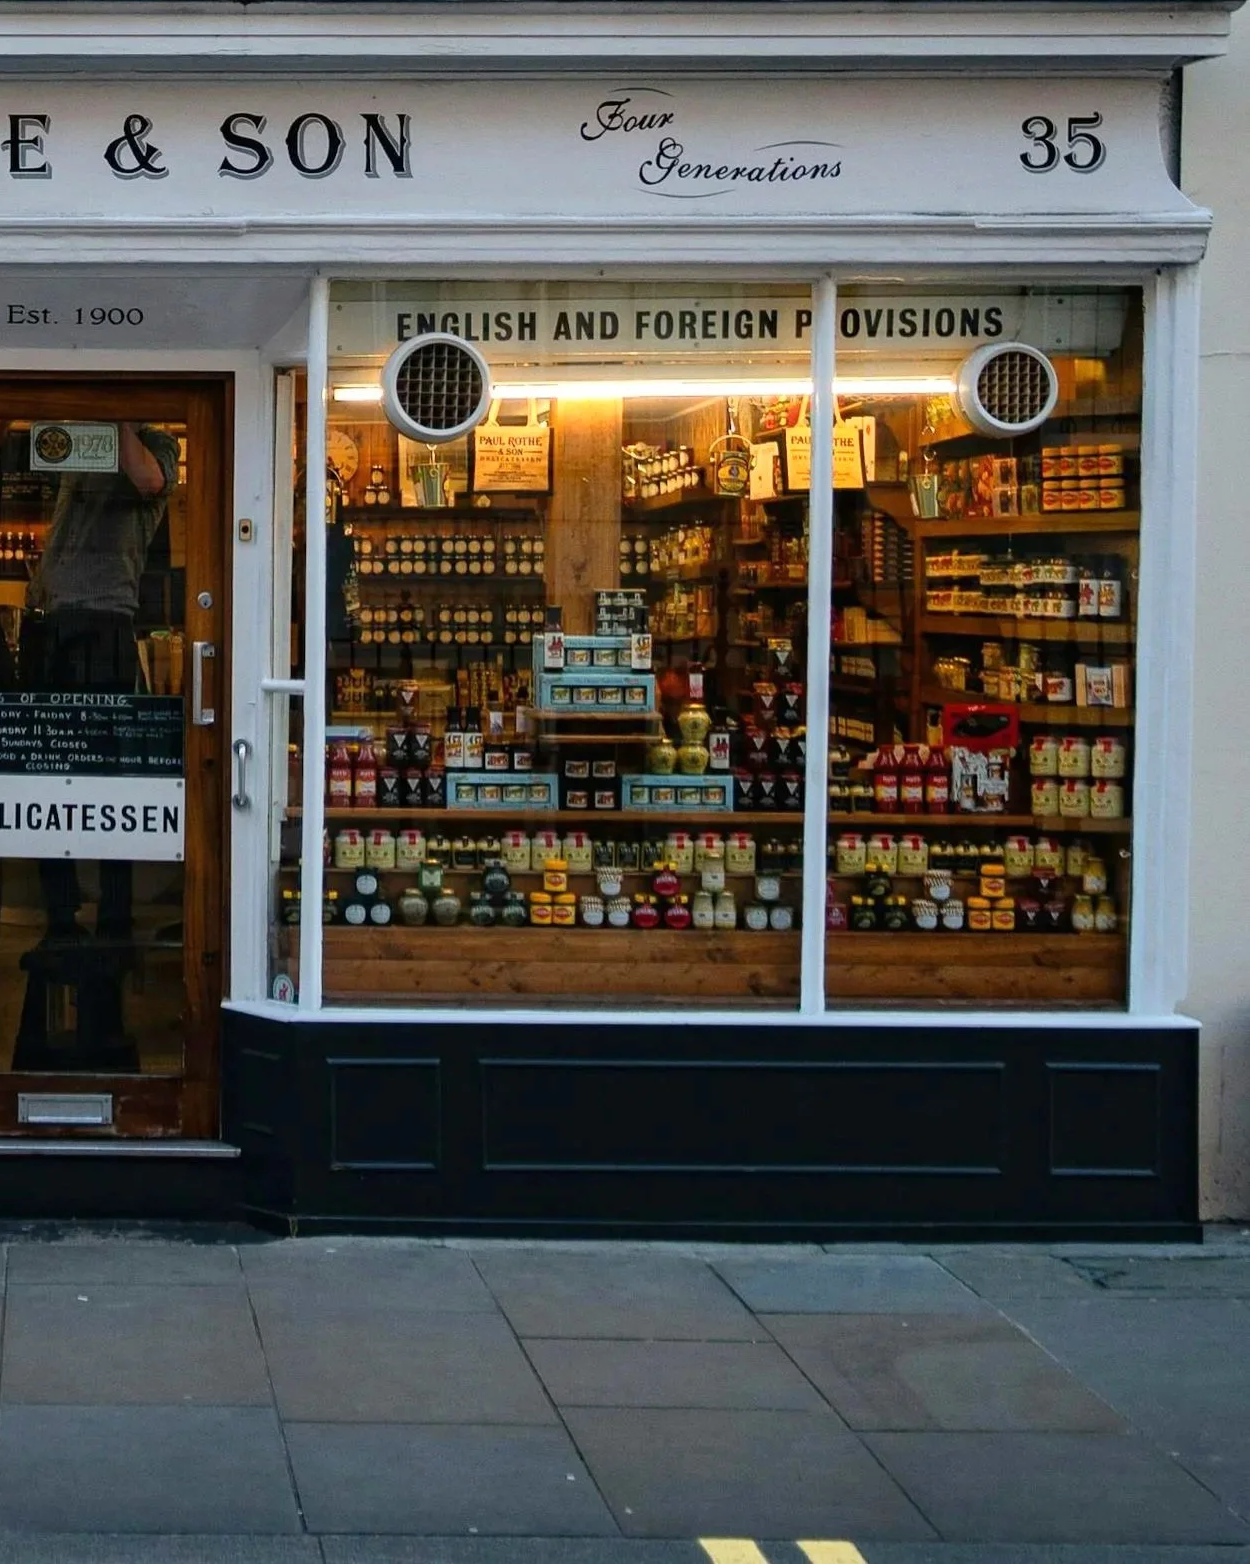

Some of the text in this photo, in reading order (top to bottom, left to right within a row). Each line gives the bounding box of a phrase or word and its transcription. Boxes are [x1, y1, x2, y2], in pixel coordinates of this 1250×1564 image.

[580, 98, 674, 141] Four
[104, 113, 169, 180] &
[218, 113, 413, 180] SON
[1019, 110, 1107, 174] 35
[639, 137, 842, 186] Generations
[6, 304, 144, 325] Est. 1900
[397, 307, 1004, 342] ENGLISH AND FOREIGN POVISIONS
[479, 436, 543, 447] PAUL ROTHE
[506, 448, 523, 456] SON
[791, 436, 811, 445] PAU
[20, 693, 36, 704] OF
[50, 693, 128, 706] OPENING
